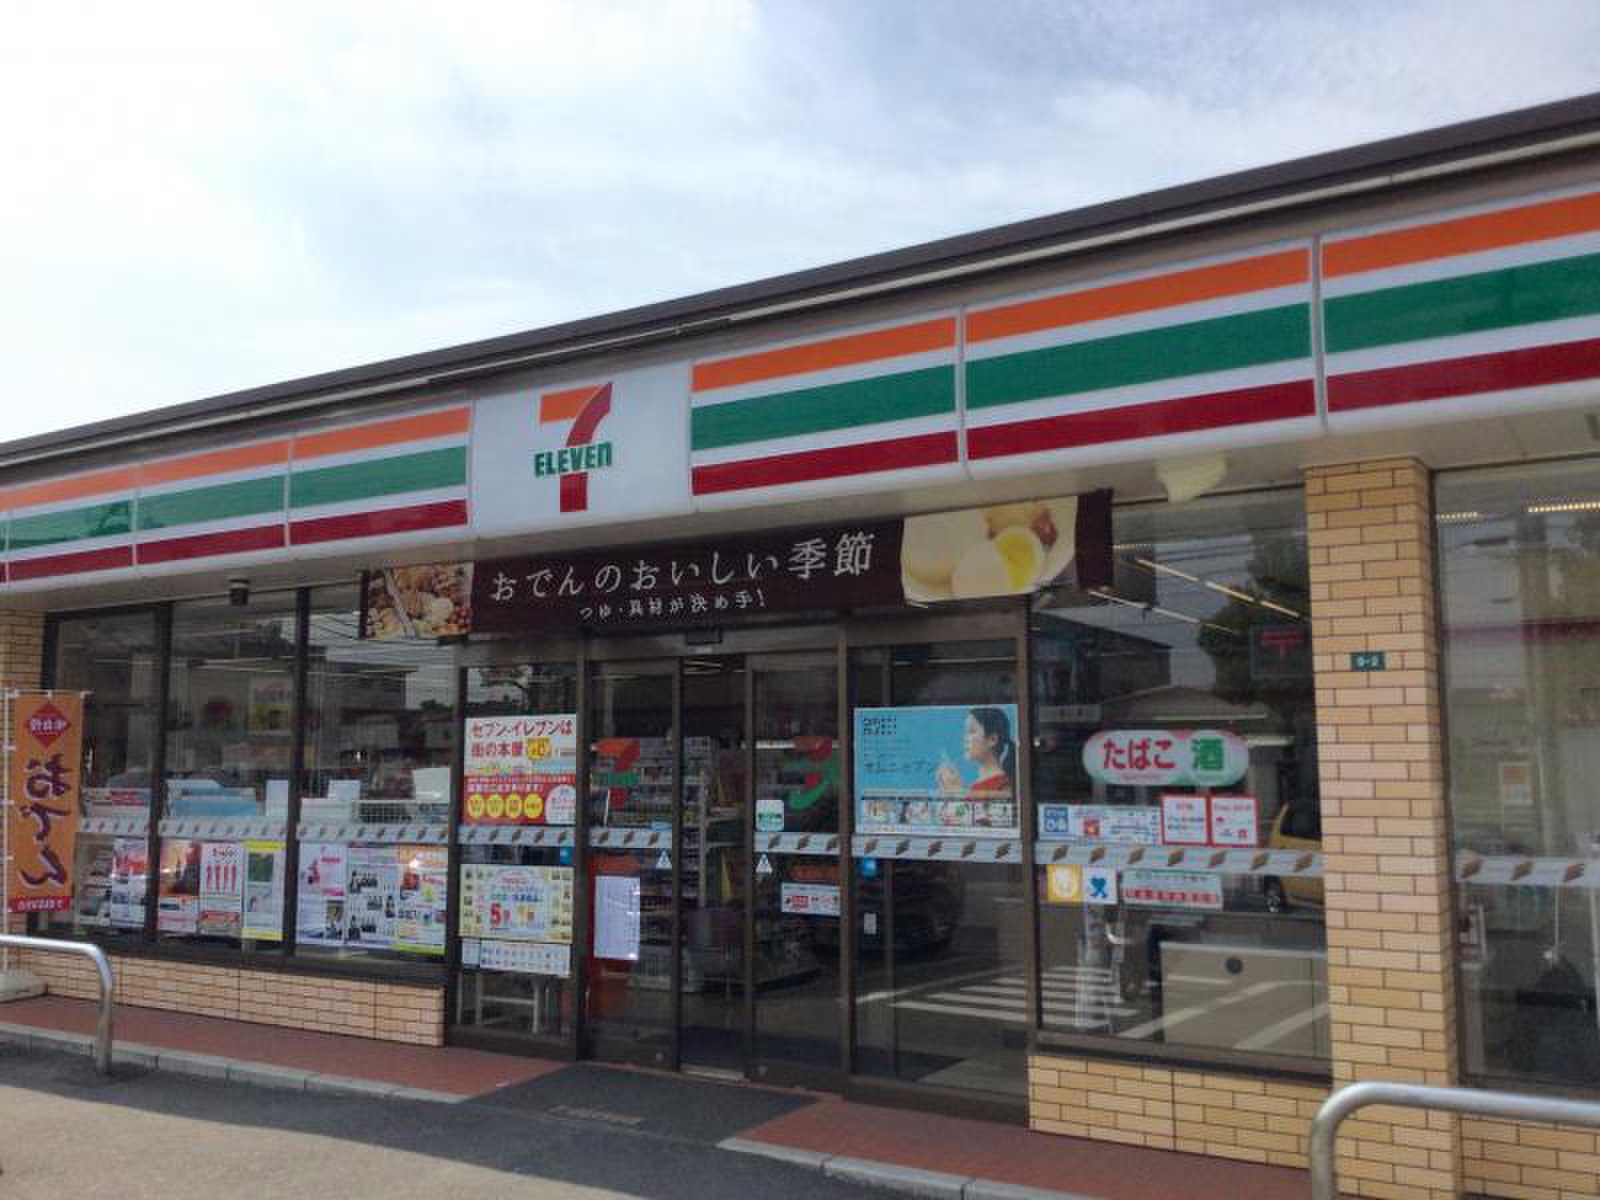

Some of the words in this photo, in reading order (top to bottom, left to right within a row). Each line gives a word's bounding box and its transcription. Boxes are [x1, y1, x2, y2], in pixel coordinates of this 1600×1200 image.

[491, 531, 875, 601] おでんのおいしい季節
[1103, 738, 1176, 769] たばこ
[1191, 738, 1225, 770] 酒
